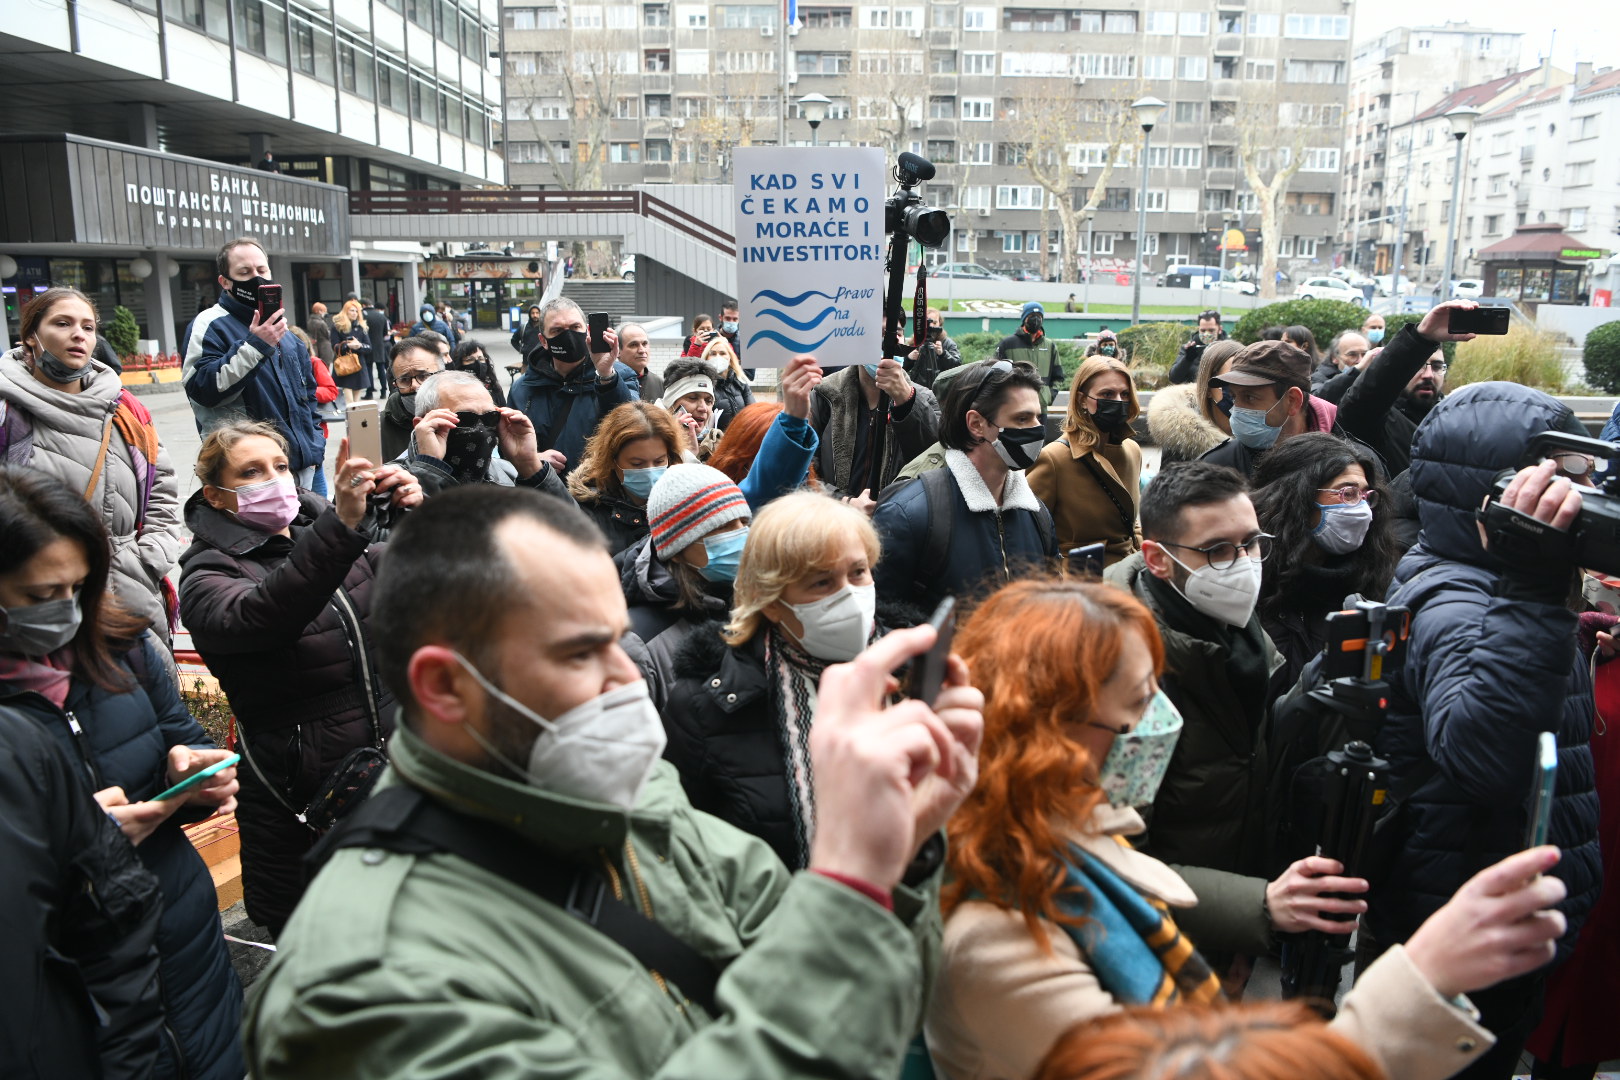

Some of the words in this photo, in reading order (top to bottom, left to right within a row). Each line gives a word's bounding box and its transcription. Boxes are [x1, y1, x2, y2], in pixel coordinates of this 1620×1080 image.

[210, 173, 260, 198] БАНКА
[750, 173, 797, 191] KAD
[811, 173, 859, 190] SVI
[126, 183, 232, 214] ПОШТАНСКА
[241, 198, 325, 226] ШТЕДИОНИЦА
[740, 194, 870, 215] ČEKAMO
[304, 225, 310, 238] 3
[756, 217, 850, 239] MORAĆE
[863, 221, 870, 237] I
[743, 244, 880, 263] INVESTITOR!
[455, 261, 513, 275] PEKARA
[916, 287, 924, 306] EOS
[834, 309, 850, 320] na
[831, 320, 865, 337] vodu
[1510, 515, 1544, 534] Canon
